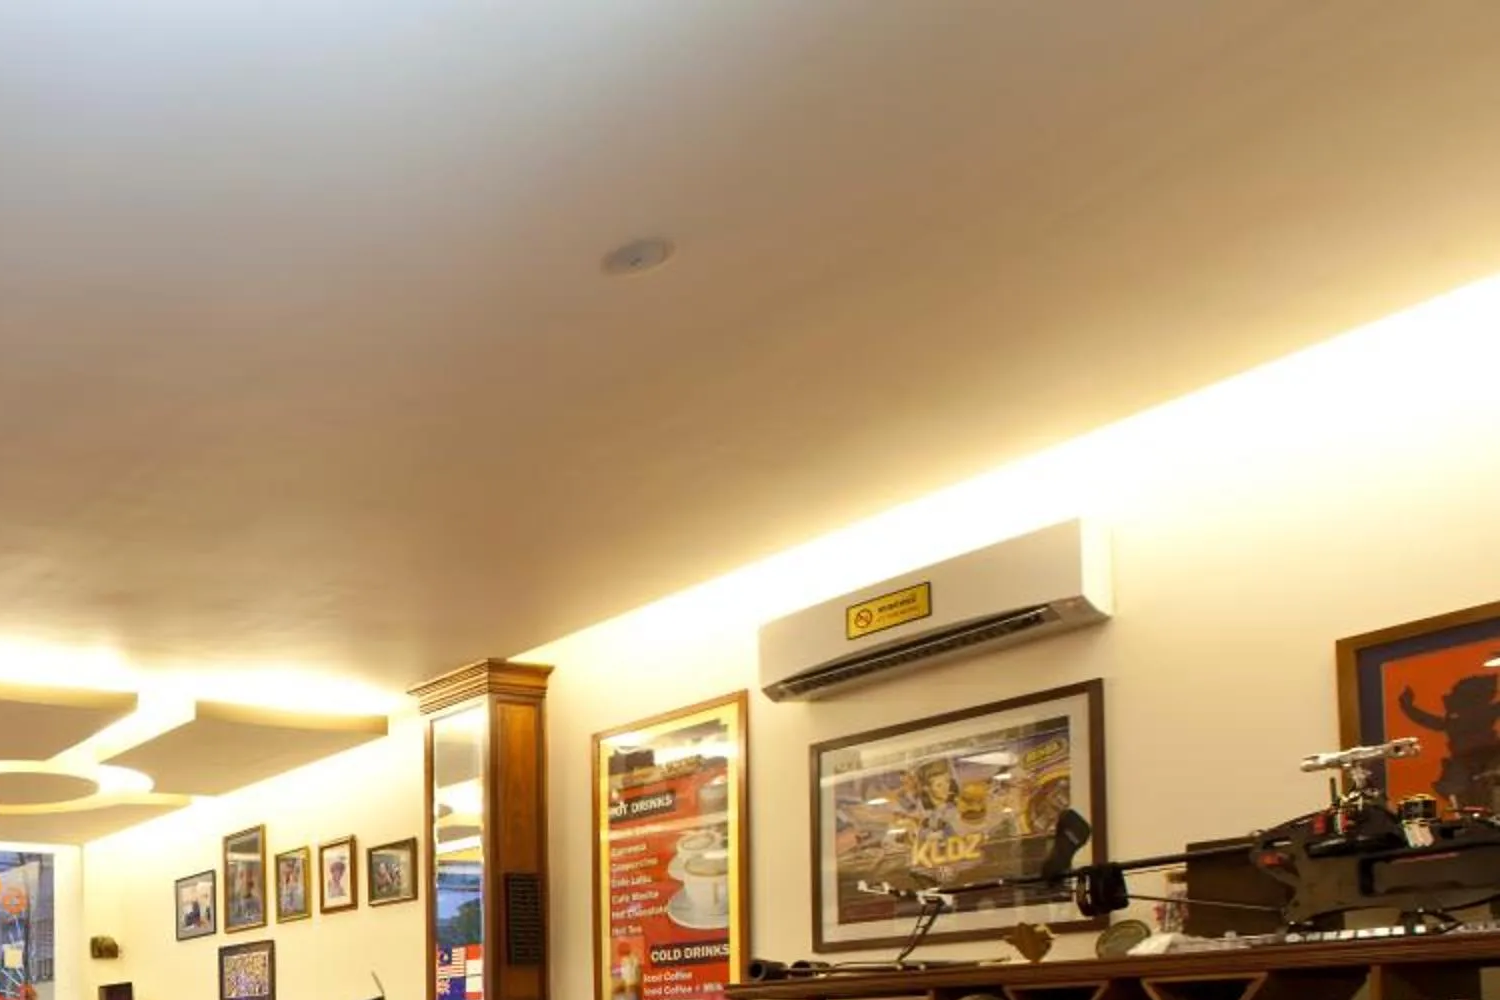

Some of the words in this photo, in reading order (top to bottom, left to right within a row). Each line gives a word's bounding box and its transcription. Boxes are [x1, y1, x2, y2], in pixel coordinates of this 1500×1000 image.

[631, 794, 673, 812] DRINKS
[651, 948, 682, 962] COLD
[684, 943, 730, 960] DRINKS
